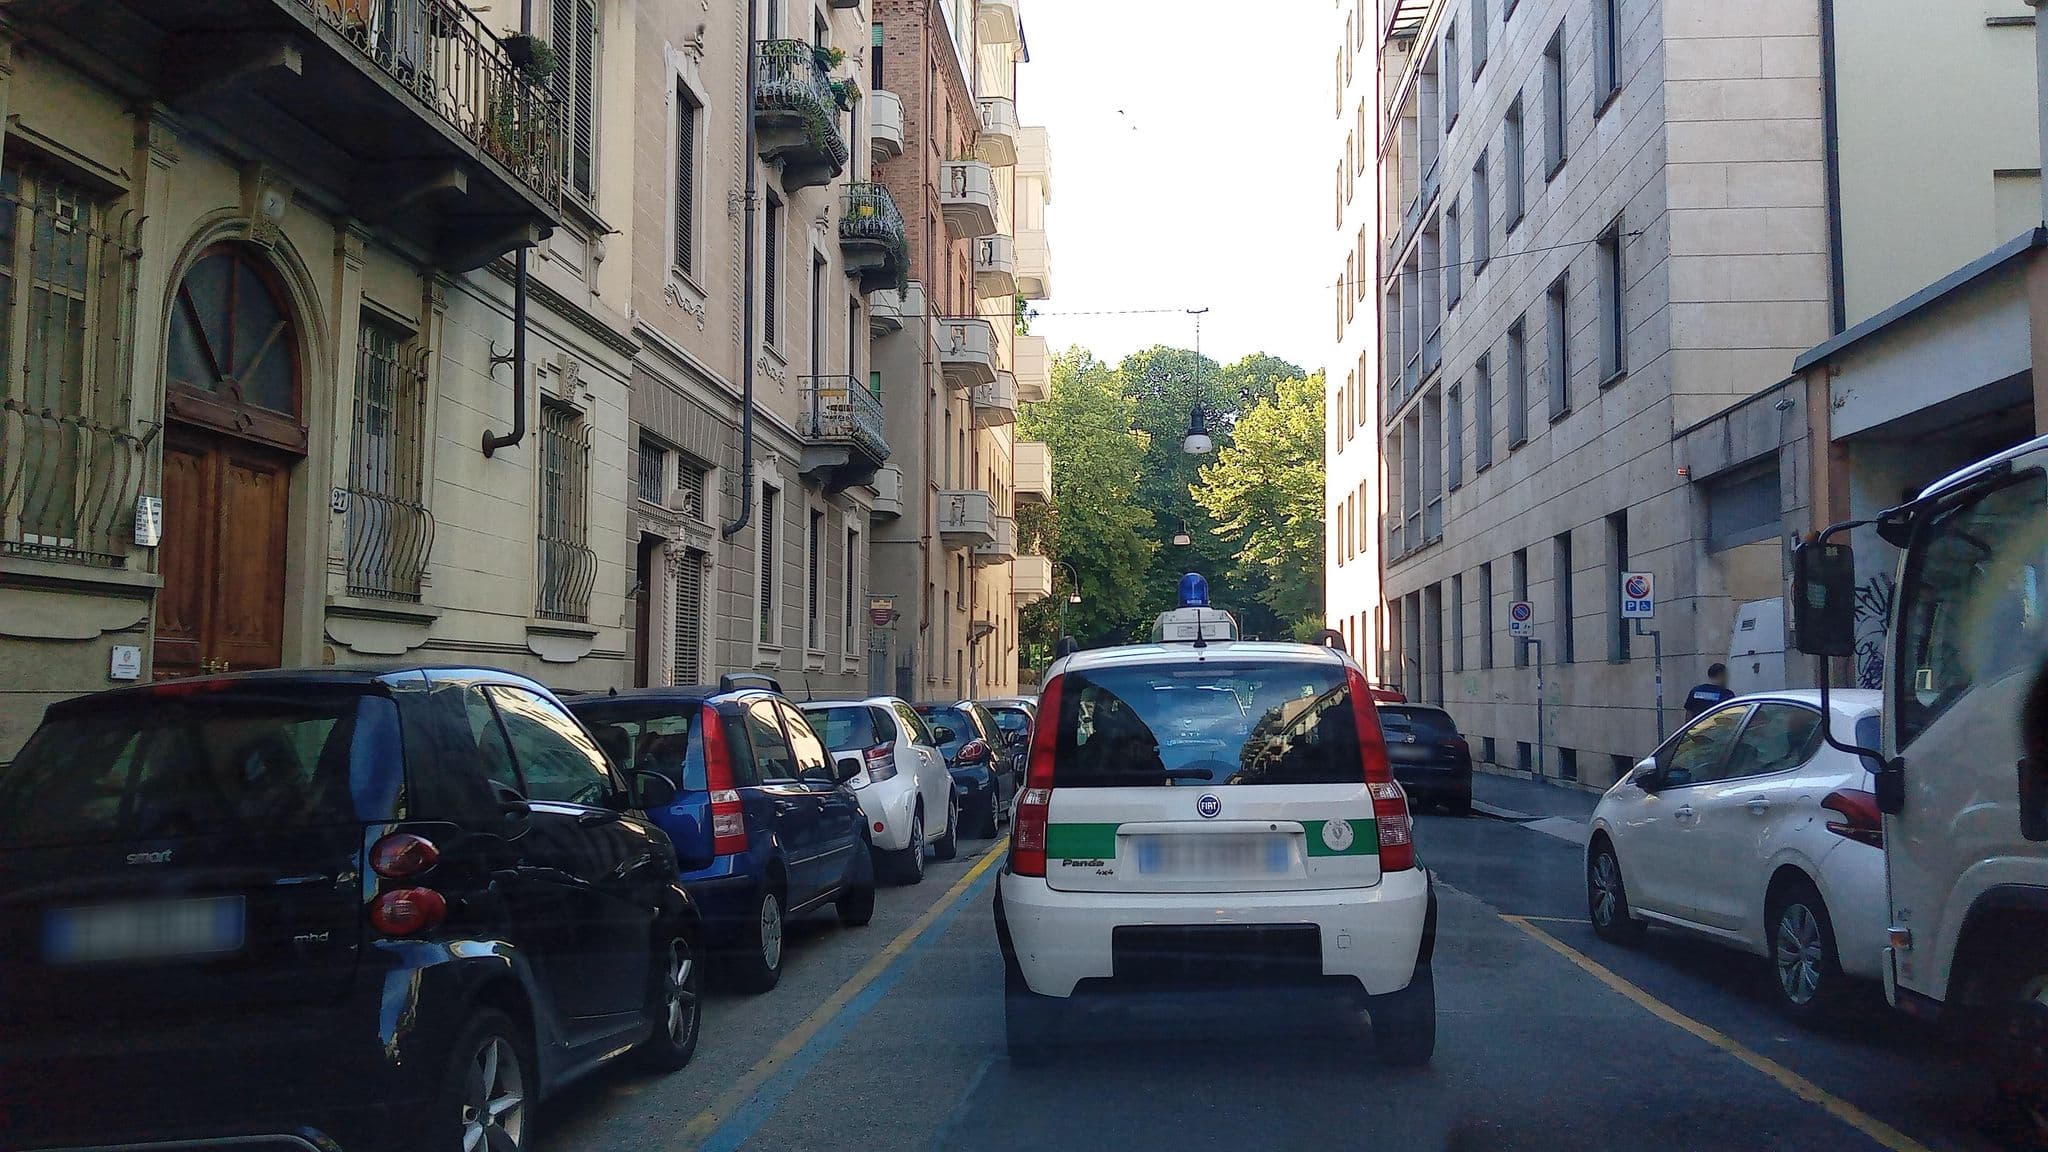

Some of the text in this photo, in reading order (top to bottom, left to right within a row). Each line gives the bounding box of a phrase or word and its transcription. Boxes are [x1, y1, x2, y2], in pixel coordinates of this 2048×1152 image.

[333, 490, 346, 508] 27
[1200, 801, 1217, 810] FIAT
[126, 849, 172, 864] smart
[1062, 857, 1105, 867] Panda
[1096, 868, 1114, 876] 4x4
